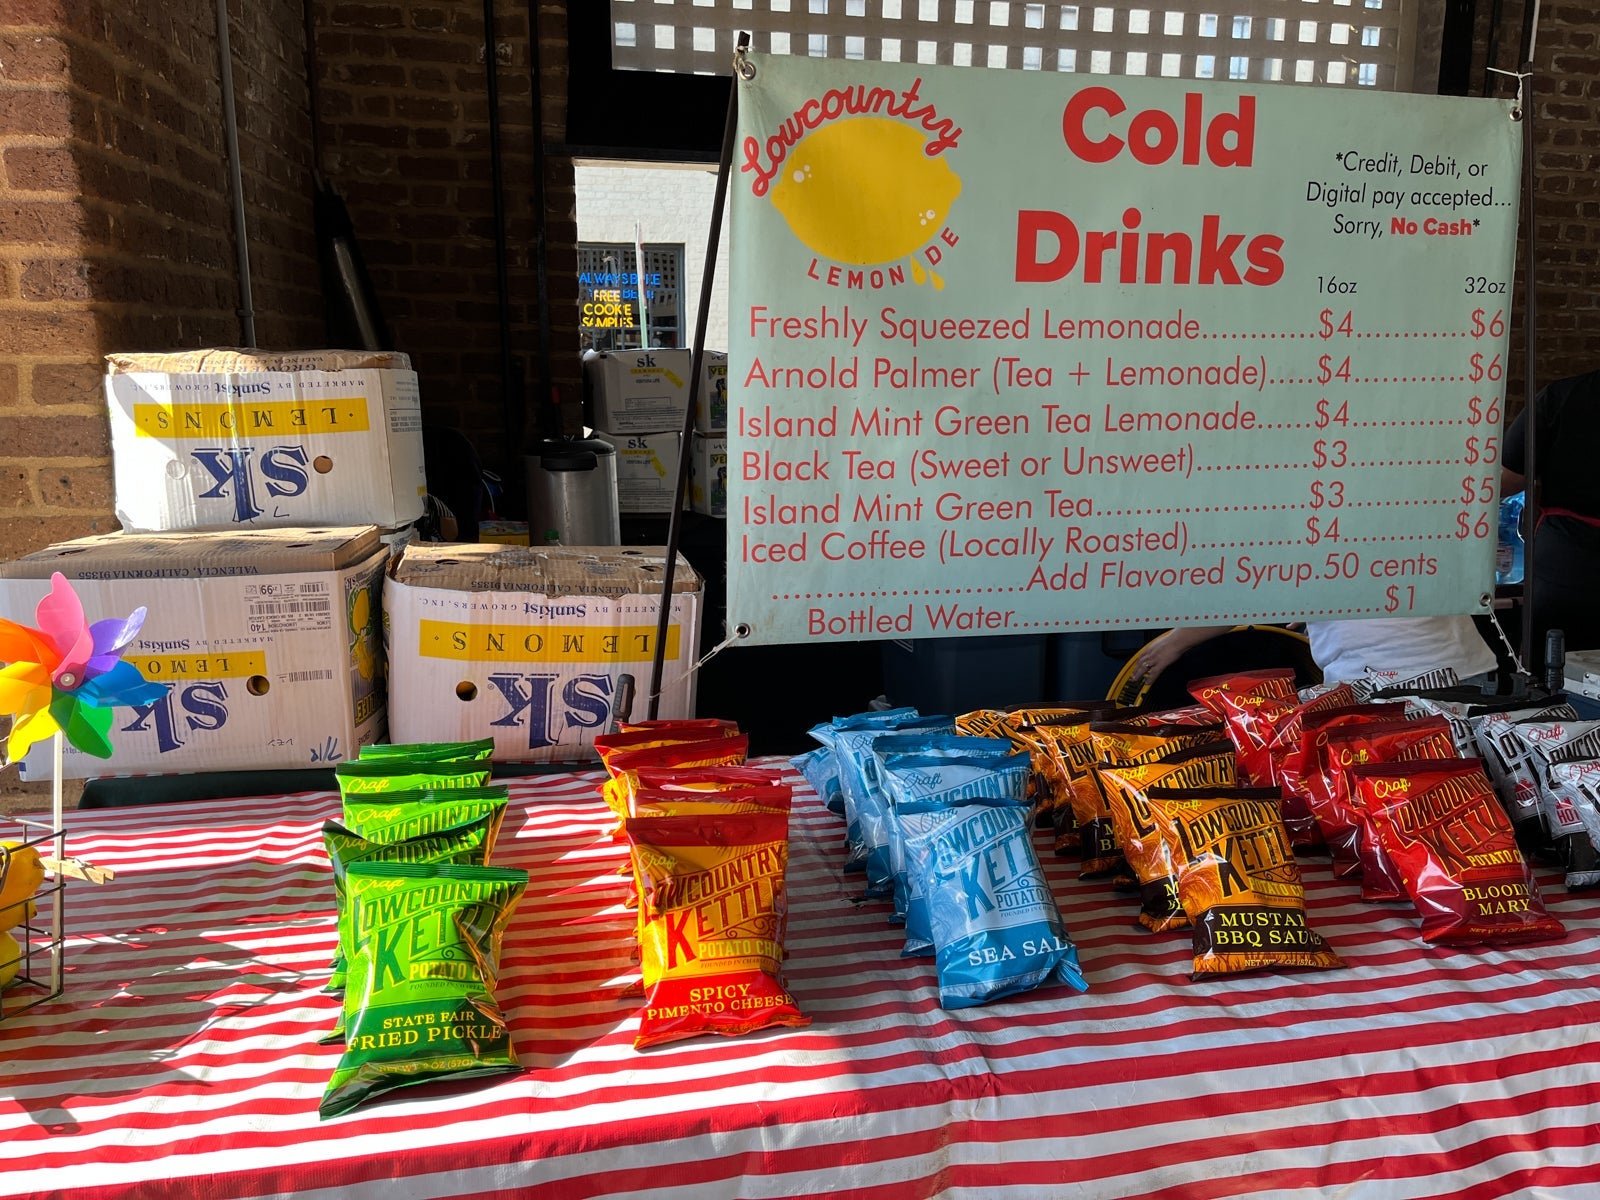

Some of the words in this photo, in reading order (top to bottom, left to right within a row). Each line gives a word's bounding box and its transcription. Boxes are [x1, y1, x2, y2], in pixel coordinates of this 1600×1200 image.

[741, 77, 963, 197] Lowcountry
[1062, 86, 1256, 168] Cold
[1410, 154, 1461, 180] Debit,
[1468, 163, 1488, 177] or
[1306, 181, 1367, 208] Digital
[1372, 191, 1406, 209] pay
[1333, 213, 1384, 240] Sorry,
[1390, 217, 1418, 236] No
[1015, 207, 1286, 287] Drinks
[807, 226, 960, 290] LEMONDE
[629, 273, 661, 285] BKE
[1317, 275, 1358, 295] 16oz
[1464, 276, 1507, 295] 32oz
[593, 289, 621, 302] FREE
[583, 303, 632, 316] COOKE
[750, 305, 869, 348] Freshly
[879, 307, 1030, 348] Squeezed
[1044, 308, 1200, 340] Lemonade
[1318, 307, 1354, 341] $4
[1470, 307, 1505, 340] $6
[637, 354, 656, 368] sk
[743, 355, 859, 389] Arnold
[873, 355, 981, 389] Palmer
[993, 356, 1052, 395] (Tea
[1068, 361, 1090, 386] +
[1106, 354, 1266, 392] Lemonade)
[1316, 352, 1352, 387] $4
[1467, 351, 1503, 385] $6
[213, 381, 272, 395] Sunkist
[277, 382, 293, 390] BY
[299, 380, 365, 389] MARKETED
[157, 407, 338, 430] LEMONS
[738, 405, 838, 438] Island
[850, 406, 923, 437] Mint
[934, 405, 1029, 436] Green
[1041, 404, 1091, 434] Tea
[1104, 400, 1256, 433] Lemonade
[1314, 397, 1350, 431] $4
[1466, 395, 1501, 427] $6
[742, 449, 830, 481] Black
[841, 450, 895, 480] Tea
[910, 449, 1010, 487] (Sweet
[1020, 456, 1051, 477] or
[1063, 442, 1194, 479] Unsweet)
[1311, 438, 1348, 470] $3
[1463, 434, 1498, 466] $5
[191, 445, 310, 524] sk
[743, 493, 840, 525] Island
[852, 493, 924, 523] Mint
[935, 492, 1033, 522] Green
[1043, 489, 1093, 518] Tea
[1308, 479, 1345, 511] $3
[1460, 475, 1495, 506] $5
[741, 531, 807, 564] Iced
[820, 529, 926, 561] Coffee
[939, 526, 1055, 565] (Locally
[1065, 520, 1189, 557] Roasted)
[1305, 515, 1341, 547] $4
[1454, 510, 1490, 542] $6
[78, 568, 112, 580] 91355
[112, 566, 190, 578] CALIFORNIA
[1025, 561, 1089, 591] Add
[1100, 556, 1225, 589] Flavored
[1369, 552, 1438, 578] cents
[501, 582, 571, 593] CALIFORNIA
[574, 584, 632, 595] VALENCIA,
[418, 597, 445, 606] INC.
[449, 600, 518, 611] GROWERS,
[522, 602, 587, 619] Sunkist
[594, 606, 609, 614] BY
[616, 604, 683, 613] MKETED
[808, 603, 913, 636] Bottled
[924, 603, 1016, 631] Water
[1384, 583, 1416, 613] $1
[138, 638, 190, 653] Sunkist
[451, 631, 651, 653] LEMONS
[133, 658, 230, 674] LEMO
[487, 672, 614, 749] sk
[1234, 695, 1265, 708] Craft
[120, 681, 229, 754] sk
[1528, 724, 1564, 742] Craft
[904, 772, 942, 790] Craft
[1112, 765, 1148, 787] Craft
[1569, 760, 1600, 782] Craf
[1373, 777, 1412, 799] Craft
[356, 807, 401, 823] Craft
[1383, 769, 1494, 849] LOWCOUNTR
[1172, 799, 1282, 869] LOWCOUNTR
[1419, 798, 1514, 880] KETTL
[1211, 826, 1295, 899] KETTL
[1466, 849, 1513, 867] POTATO
[960, 828, 1036, 922] KETT
[353, 878, 405, 894] Craft
[1248, 876, 1289, 897] POTATO
[1461, 883, 1530, 901] BLOODY
[996, 888, 1045, 908] POTATO
[1478, 898, 1530, 916] MARY
[1219, 912, 1306, 928] MUSTA
[699, 940, 751, 959] POTATO
[1215, 931, 1263, 948] BBQ
[968, 946, 1016, 967] SEA
[409, 961, 466, 981] POTATO
[690, 983, 751, 1003] SPICY
[647, 1002, 725, 1021] PIMENTO
[730, 994, 793, 1011] CHEESE
[383, 1013, 435, 1030] STATE
[440, 1011, 475, 1023] FAIR
[347, 1029, 419, 1052] FRIED
[427, 1025, 502, 1043] PICKLE
